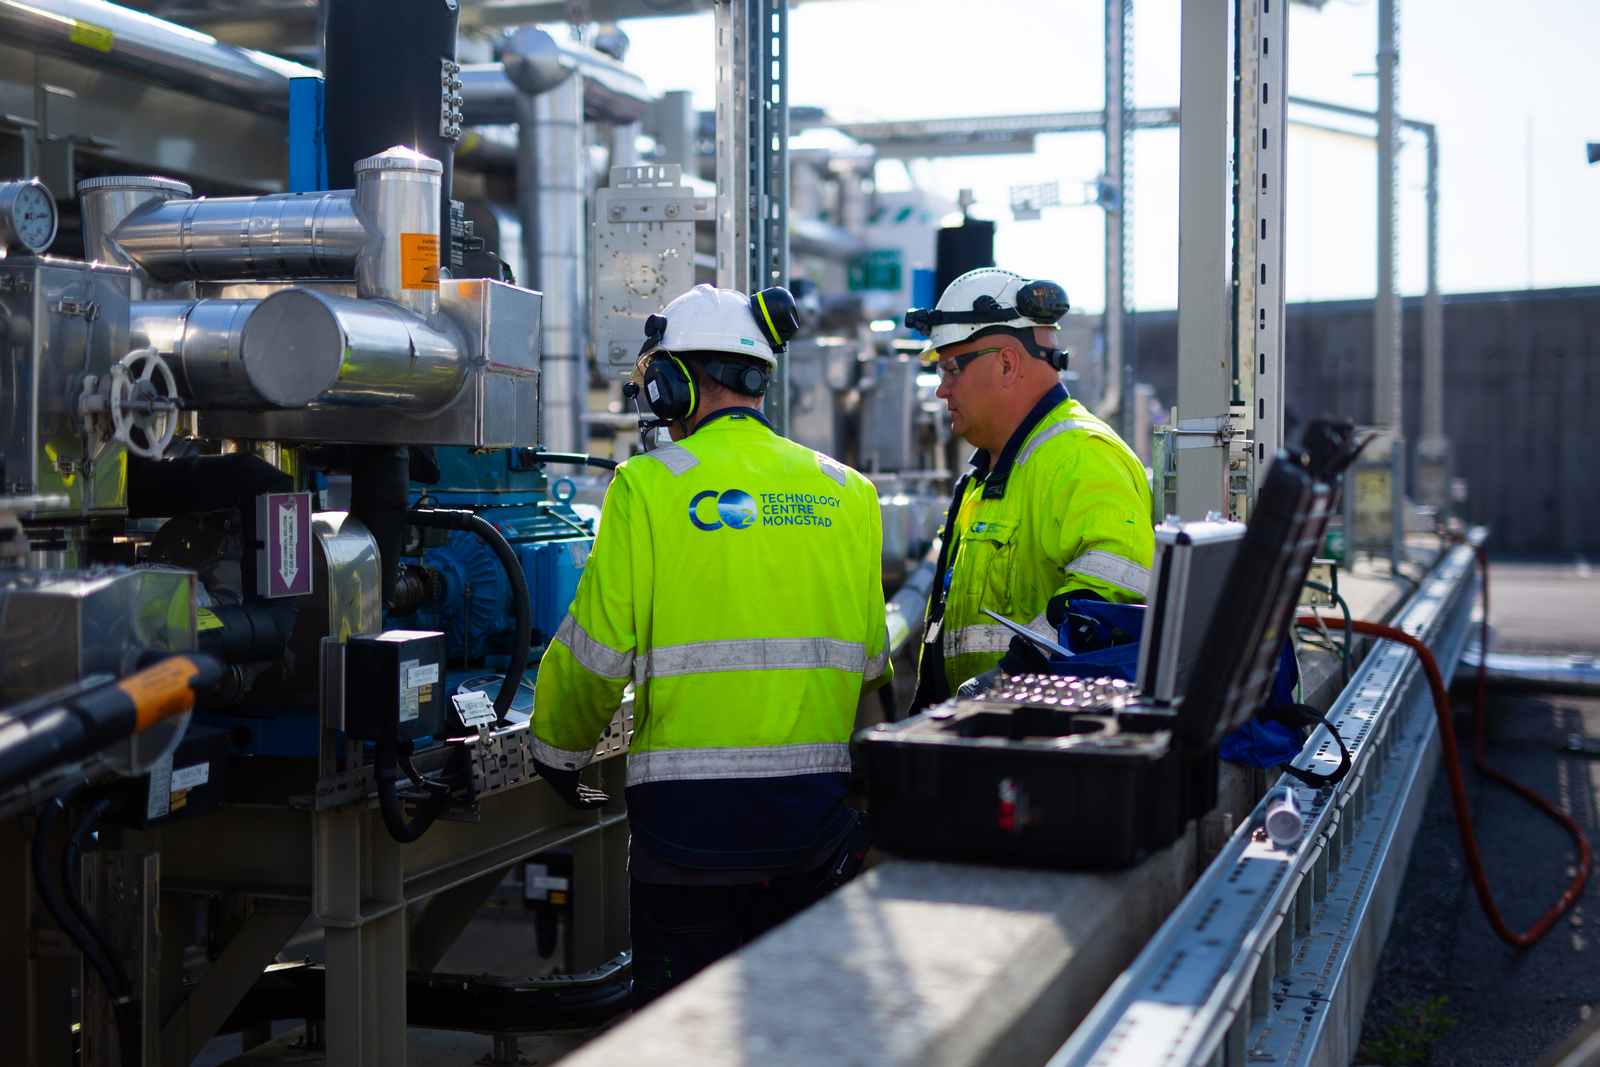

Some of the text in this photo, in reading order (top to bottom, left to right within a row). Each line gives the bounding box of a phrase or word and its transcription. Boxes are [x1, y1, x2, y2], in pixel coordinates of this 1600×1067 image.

[760, 493, 841, 508] TECHNOLOGY
[762, 504, 814, 515] CENTRE
[763, 515, 832, 528] MONGSTAD
